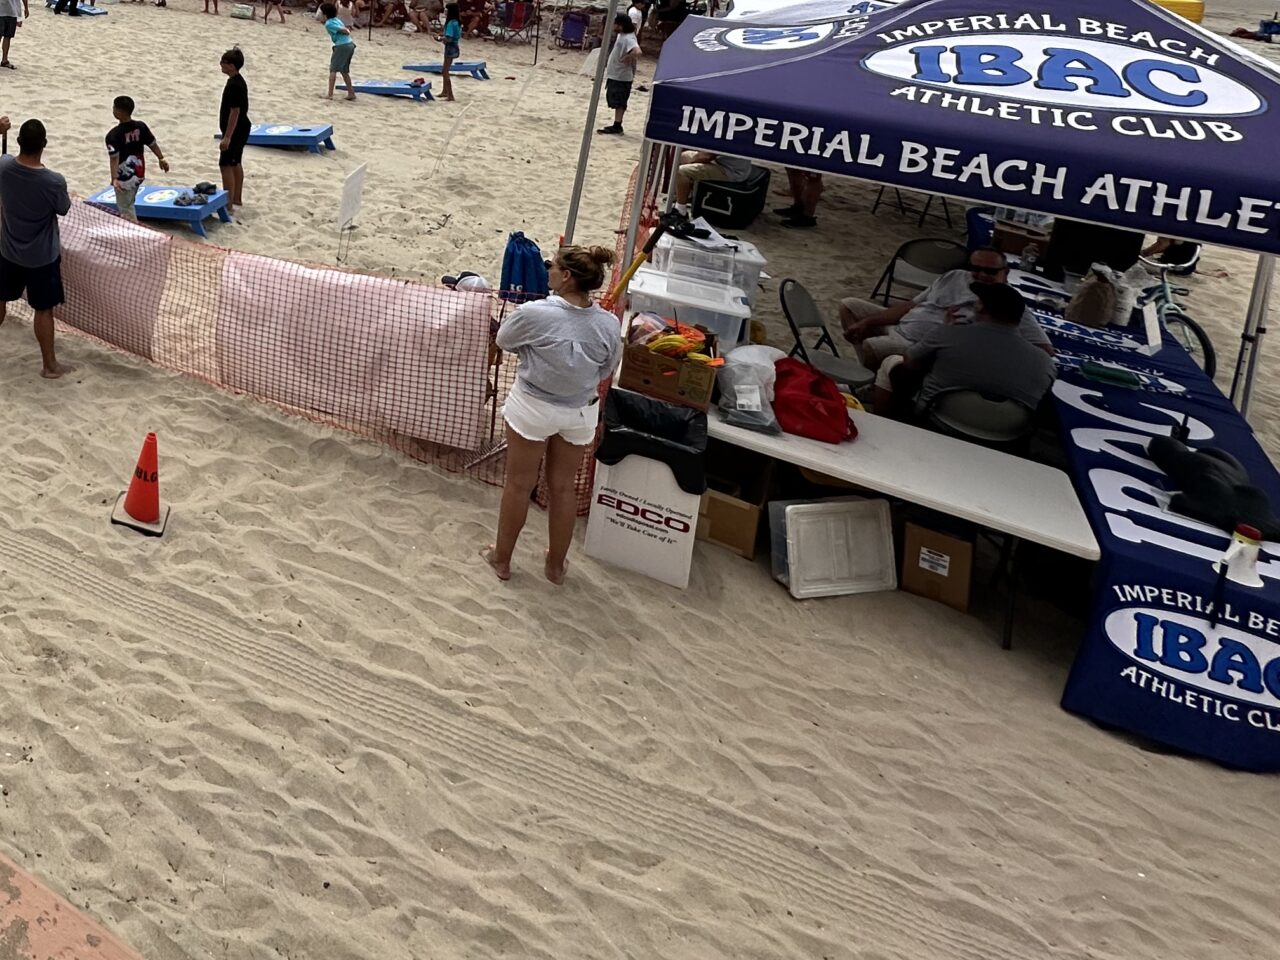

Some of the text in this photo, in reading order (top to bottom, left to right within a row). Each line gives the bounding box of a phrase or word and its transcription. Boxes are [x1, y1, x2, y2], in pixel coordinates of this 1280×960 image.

[876, 13, 1066, 44] IMPERIAL
[1077, 17, 1219, 67] BEACH
[909, 45, 1209, 108] IBAC
[890, 85, 1243, 142] ATHLETIC CLUB
[678, 105, 1280, 234] IMPERIAL BEACH ATHLE
[596, 493, 690, 533] EDCO
[600, 486, 618, 495] Family
[619, 491, 639, 502] Owned
[643, 500, 664, 511] Locally
[665, 507, 692, 519] Operated
[626, 523, 641, 533] Take
[642, 529, 658, 539] Care
[1120, 665, 1280, 732] ATHLETIC CL
